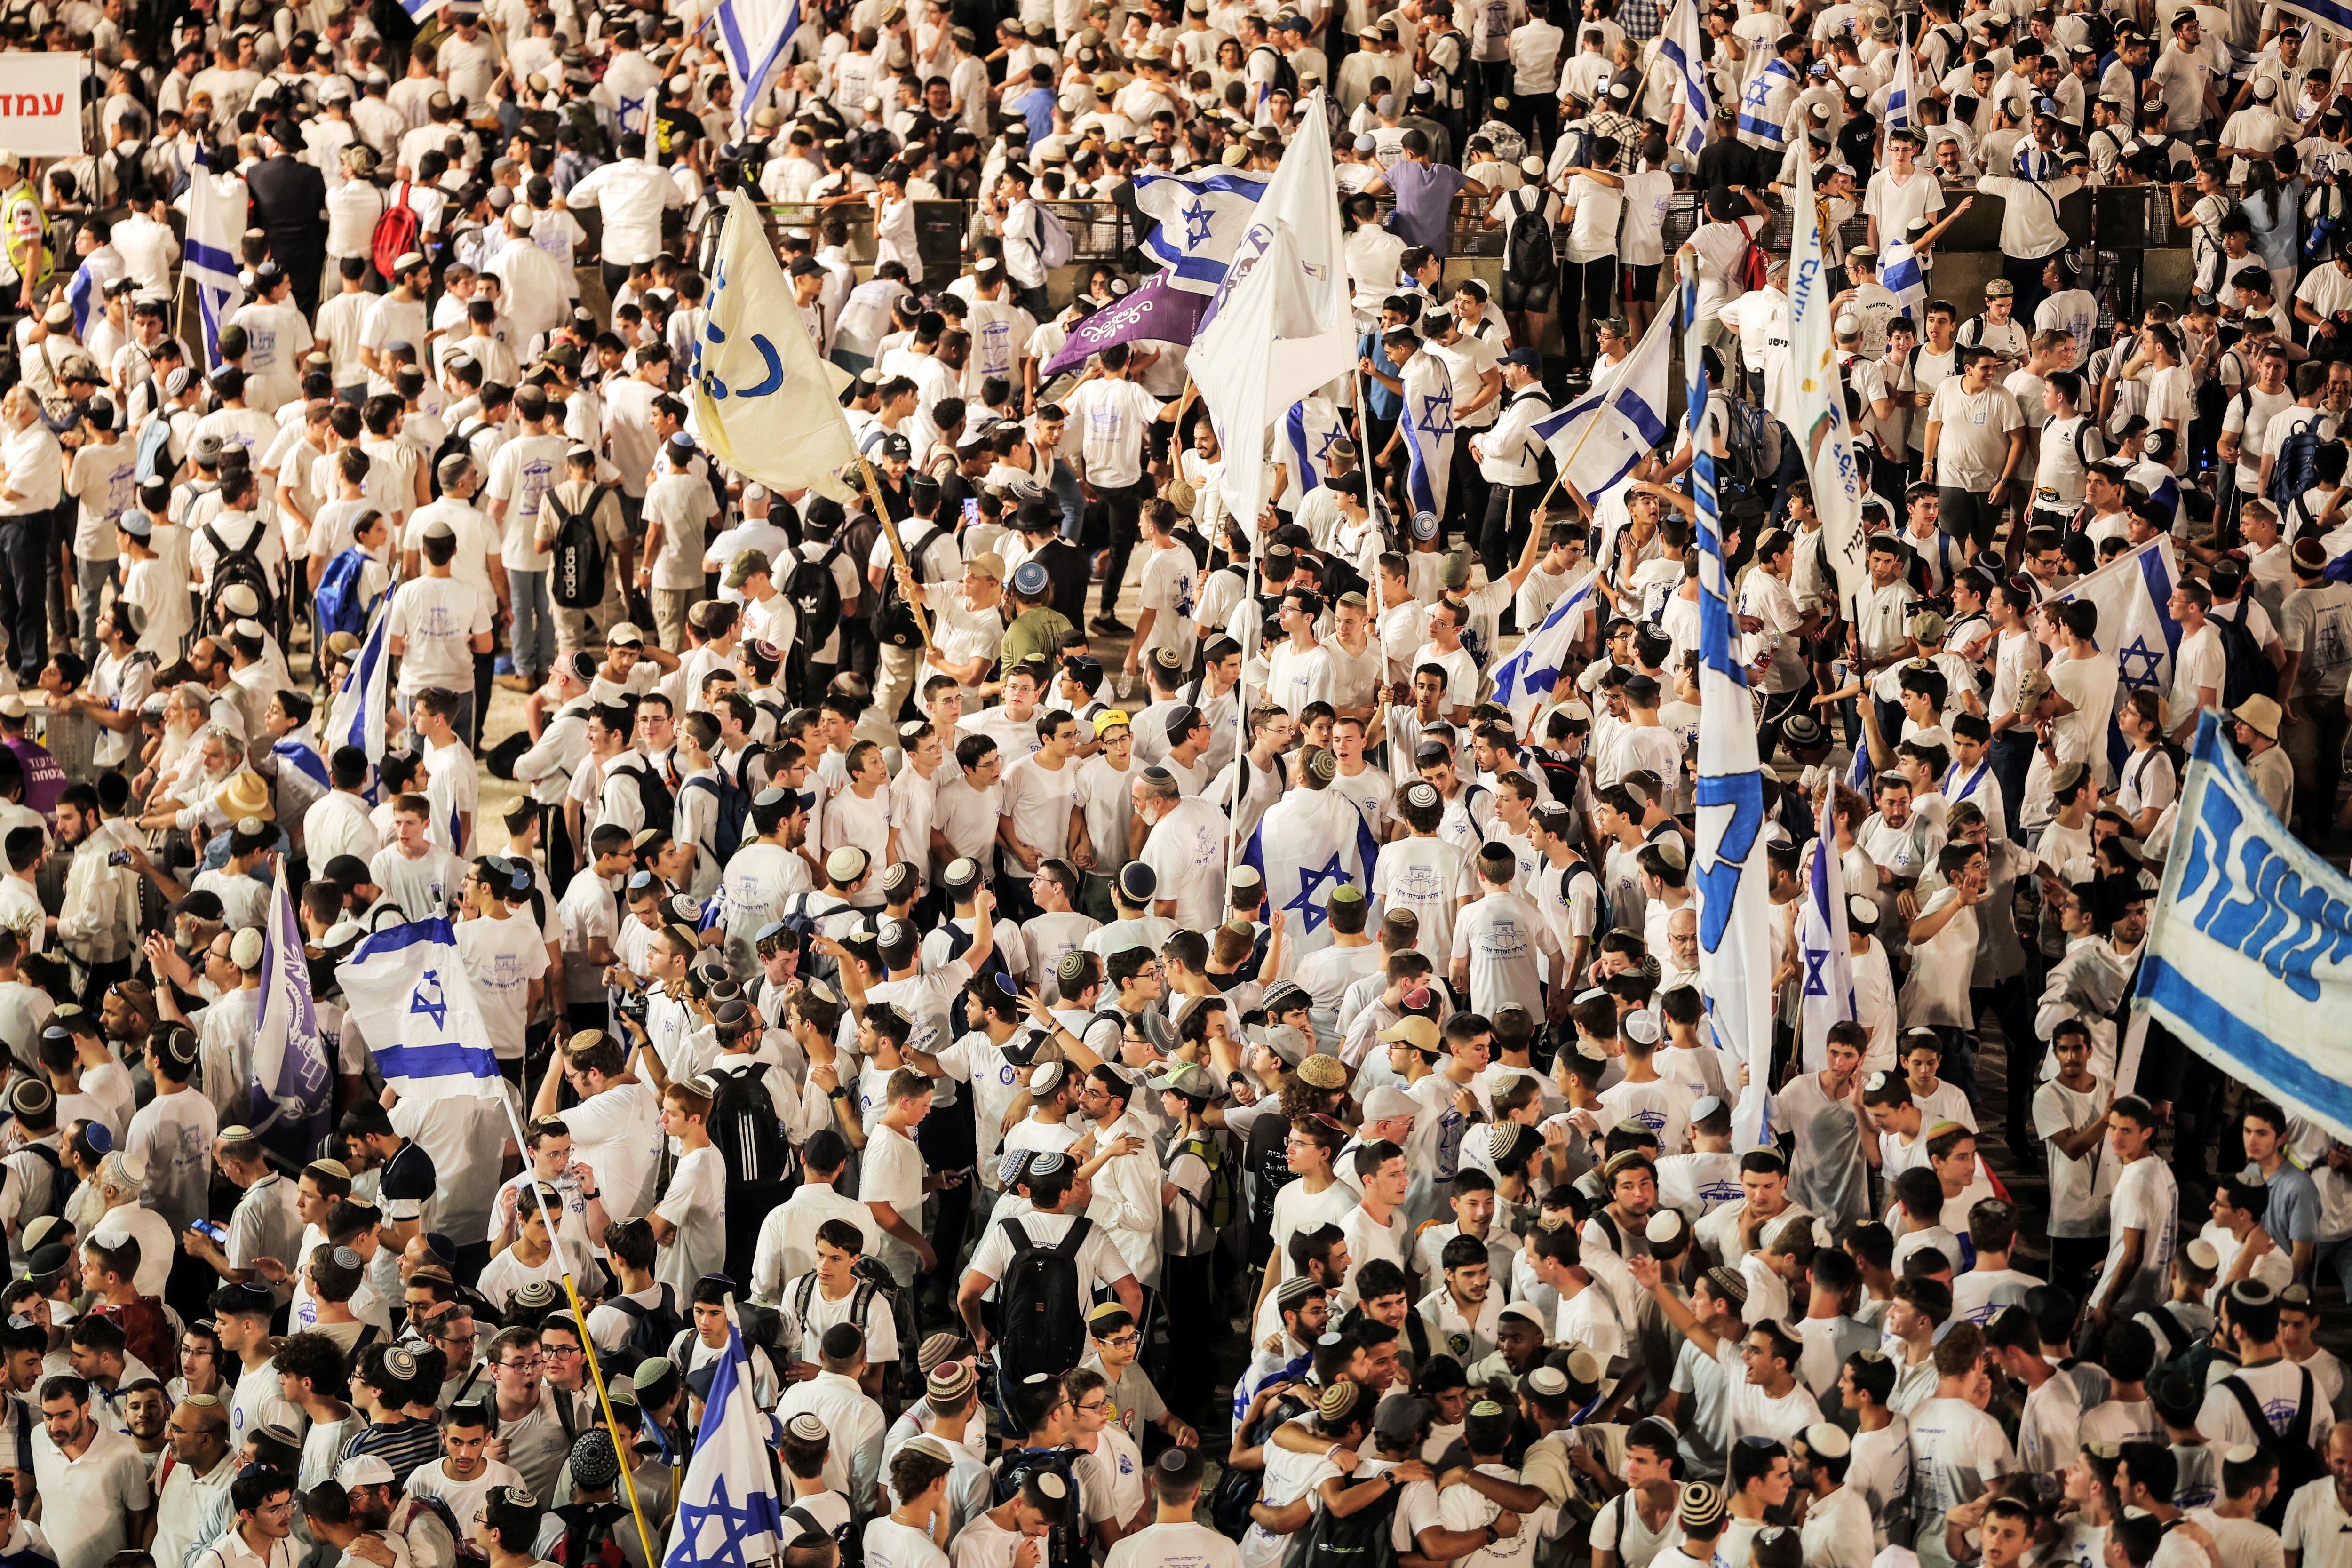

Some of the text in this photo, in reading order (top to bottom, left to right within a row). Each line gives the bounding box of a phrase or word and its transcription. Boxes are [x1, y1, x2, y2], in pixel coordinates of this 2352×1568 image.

[564, 546, 577, 599] adidas
[1395, 888, 1406, 897] אתה
[1481, 945, 1493, 954] אתה
